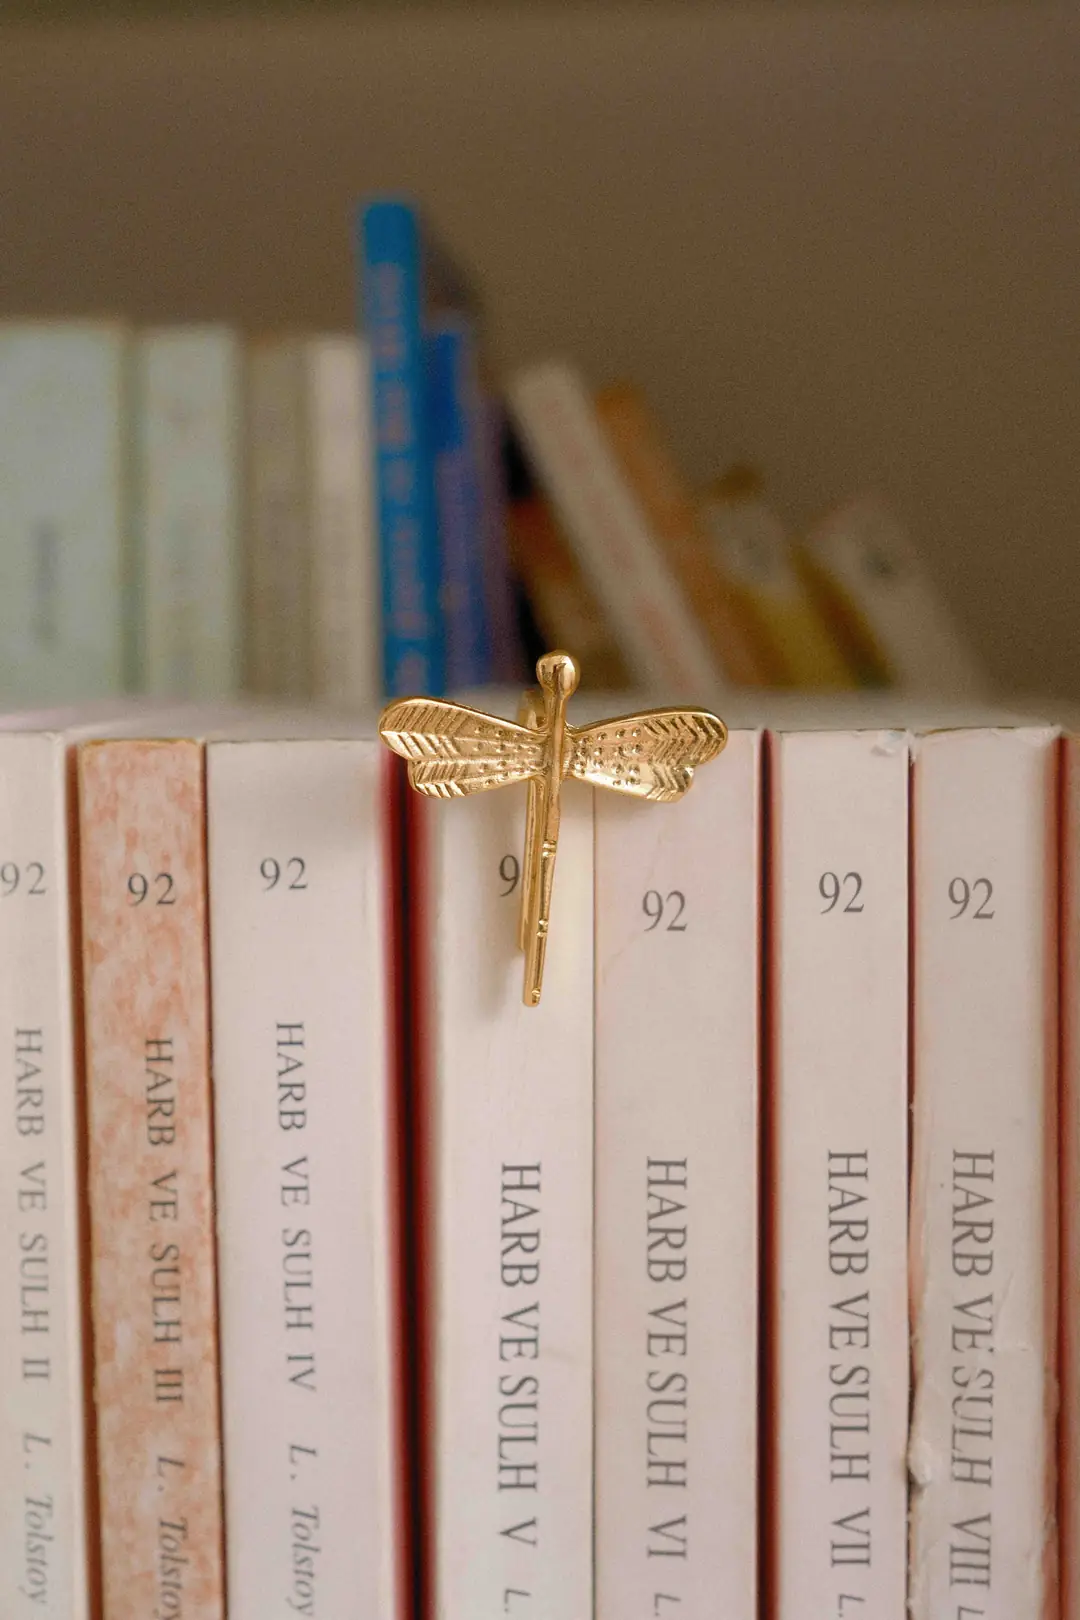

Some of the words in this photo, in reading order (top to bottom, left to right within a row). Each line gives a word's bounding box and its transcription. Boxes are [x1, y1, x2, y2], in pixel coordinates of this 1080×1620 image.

[0, 862, 46, 895] 92
[128, 873, 175, 905] 92
[260, 857, 307, 890] 92
[499, 855, 519, 897] 9
[819, 872, 864, 914] 92
[949, 877, 994, 919] 92
[643, 890, 687, 931] 92
[16, 1028, 44, 1136] HARB
[145, 1039, 175, 1146] HARB
[276, 1023, 306, 1130] HARB
[18, 1161, 47, 1211] VE
[150, 1170, 177, 1221] VE
[282, 1156, 309, 1205] VE
[501, 1163, 540, 1287] HARB
[647, 1158, 687, 1282] HARB
[828, 1150, 868, 1276] HARB
[952, 1150, 994, 1276] HARB
[20, 1233, 49, 1333] SULH
[150, 1244, 181, 1343] SULH
[283, 1229, 313, 1329] SULH
[500, 1302, 539, 1361] VE
[647, 1299, 687, 1356] VE
[829, 1292, 869, 1350] VE
[952, 1294, 994, 1353] VE
[23, 1358, 50, 1379] II
[154, 1369, 183, 1402] III
[288, 1355, 315, 1389] IV
[498, 1376, 538, 1490] SULH
[647, 1372, 687, 1488] SULH
[829, 1365, 869, 1481] SULH
[951, 1366, 994, 1487] SULH
[20, 1495, 54, 1604] Tolstoy
[500, 1517, 536, 1545] V
[648, 1515, 687, 1558] VI
[831, 1508, 870, 1567] VII
[950, 1513, 991, 1588] VIII
[287, 1506, 321, 1616] Tolstoy
